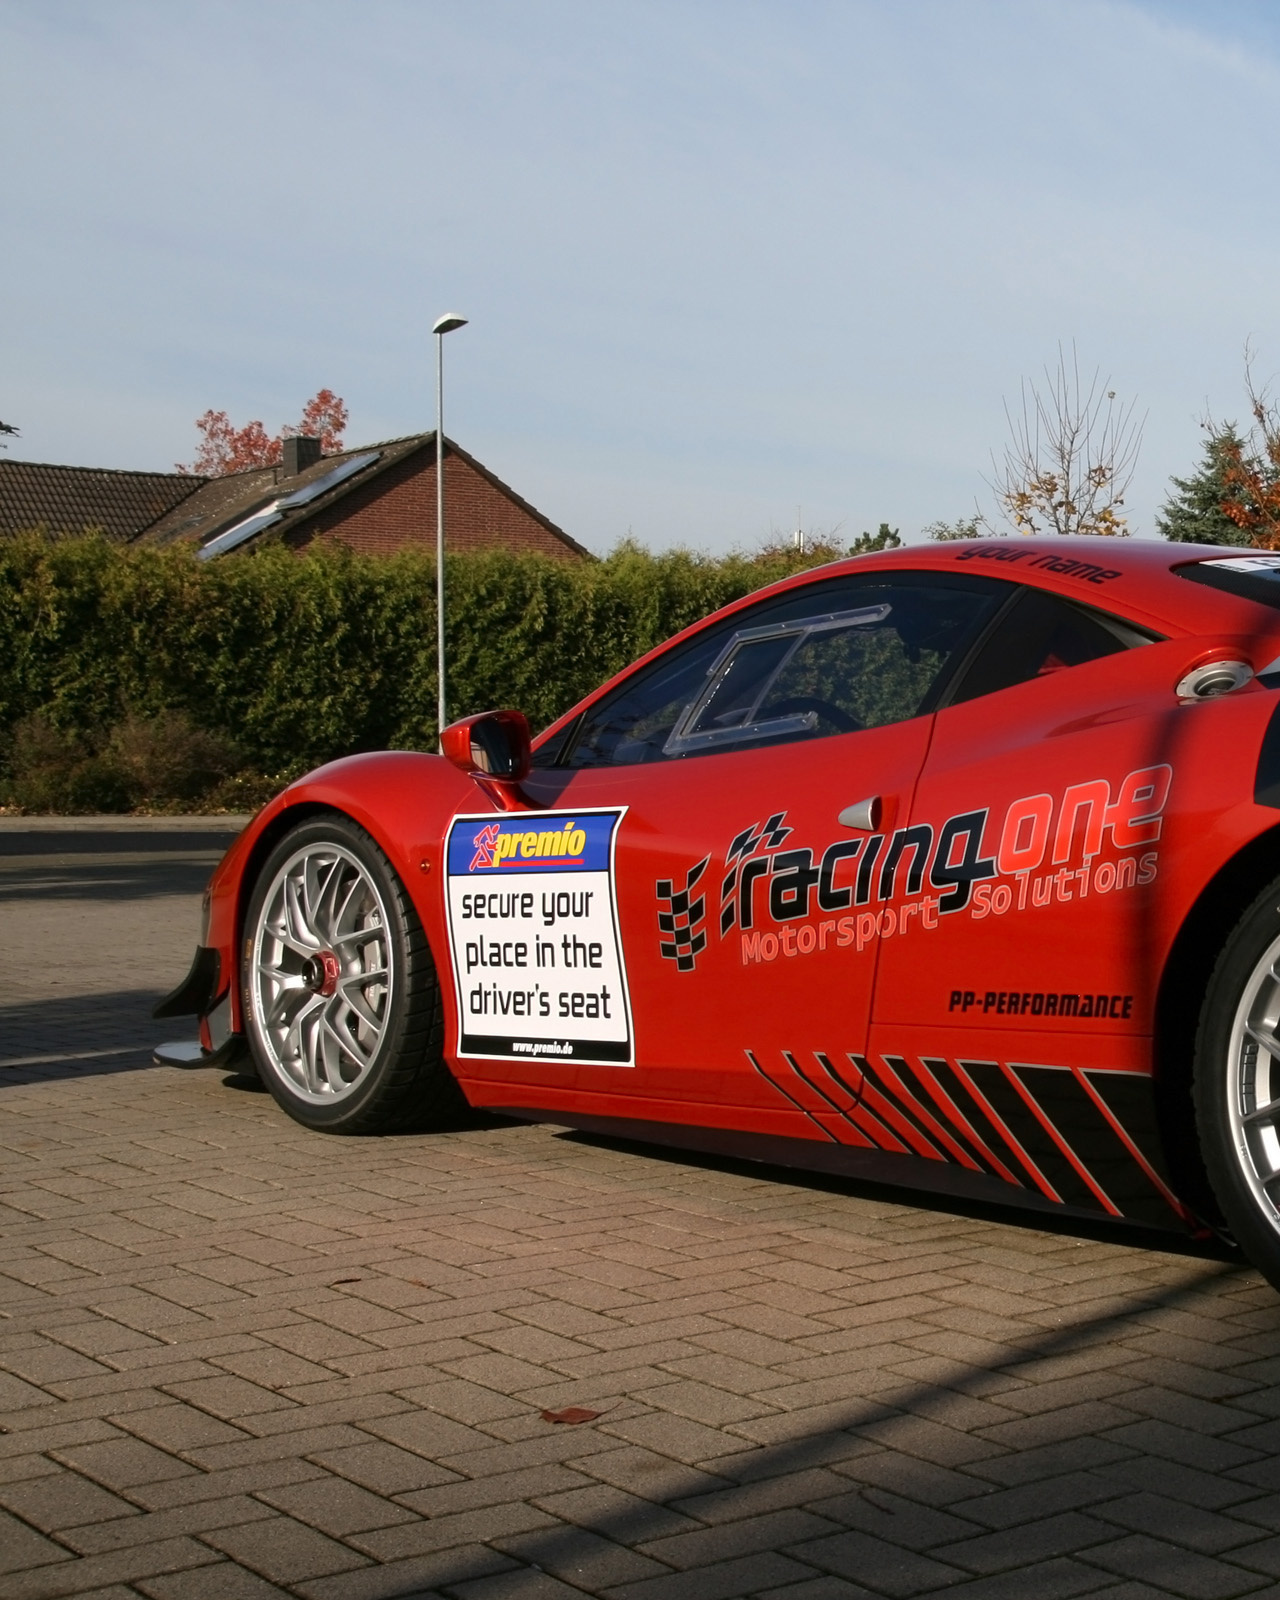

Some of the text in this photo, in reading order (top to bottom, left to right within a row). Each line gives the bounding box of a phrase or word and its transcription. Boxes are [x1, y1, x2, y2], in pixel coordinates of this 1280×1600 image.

[954, 543, 1123, 585] your name
[491, 821, 587, 867] premio
[461, 890, 594, 926] secure your
[740, 898, 939, 966] Motorsport
[465, 934, 603, 974] place in the
[469, 982, 612, 1019] driver's seat
[947, 990, 1134, 1020] PP-PERFORMANCE
[511, 1040, 574, 1056] www.premio.de
